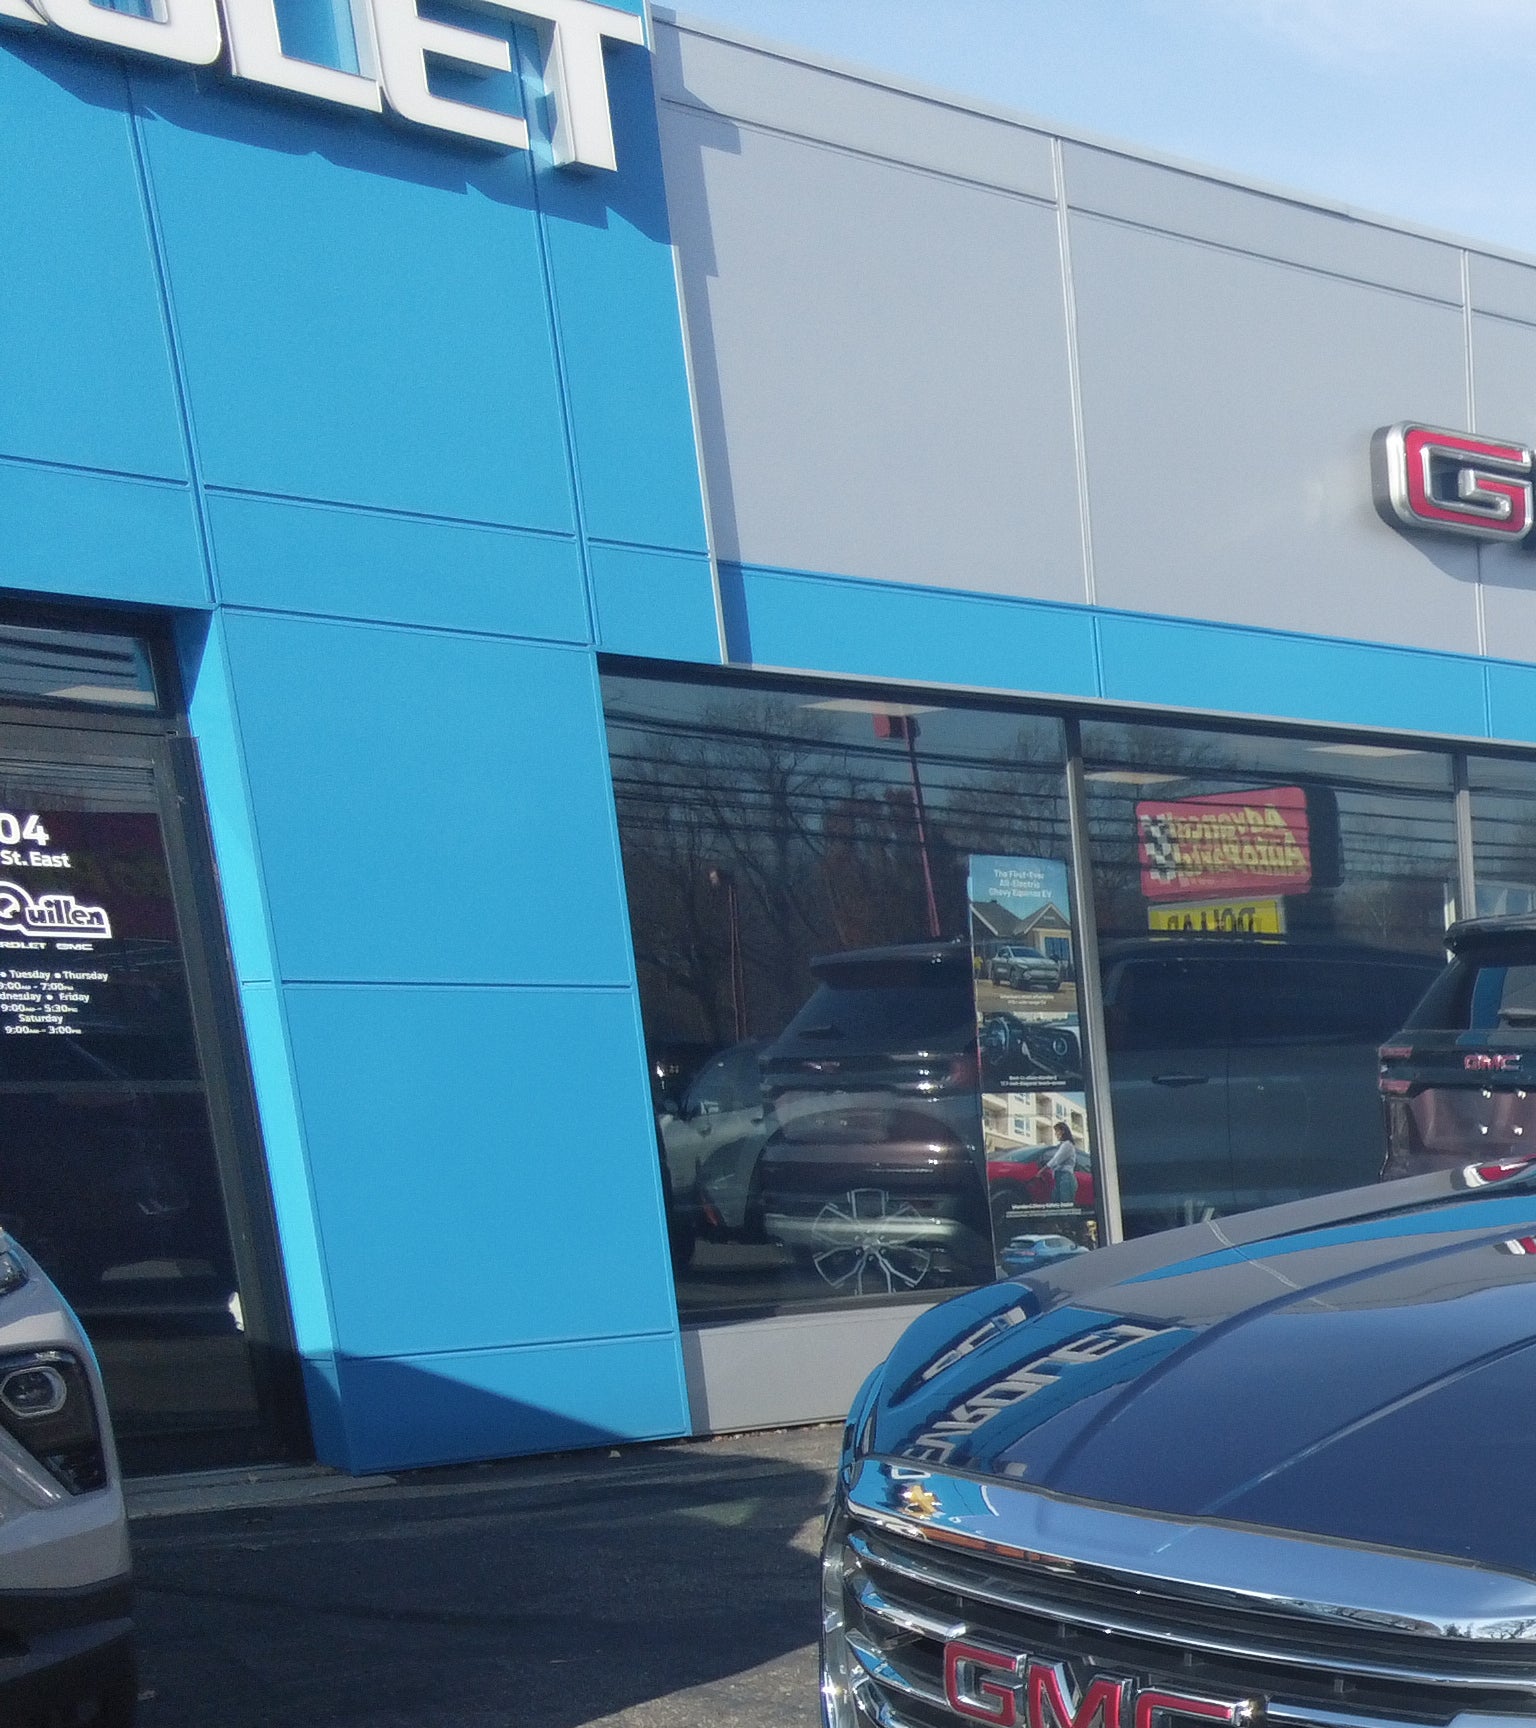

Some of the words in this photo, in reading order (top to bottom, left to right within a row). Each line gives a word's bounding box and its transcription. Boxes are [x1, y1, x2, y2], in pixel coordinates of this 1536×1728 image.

[0, 850, 29, 867] St.
[30, 851, 72, 868] East
[9, 969, 51, 981] Tuesday
[62, 970, 109, 983] Thursday
[59, 992, 90, 1004] Friday
[18, 1013, 64, 1025] Saturday
